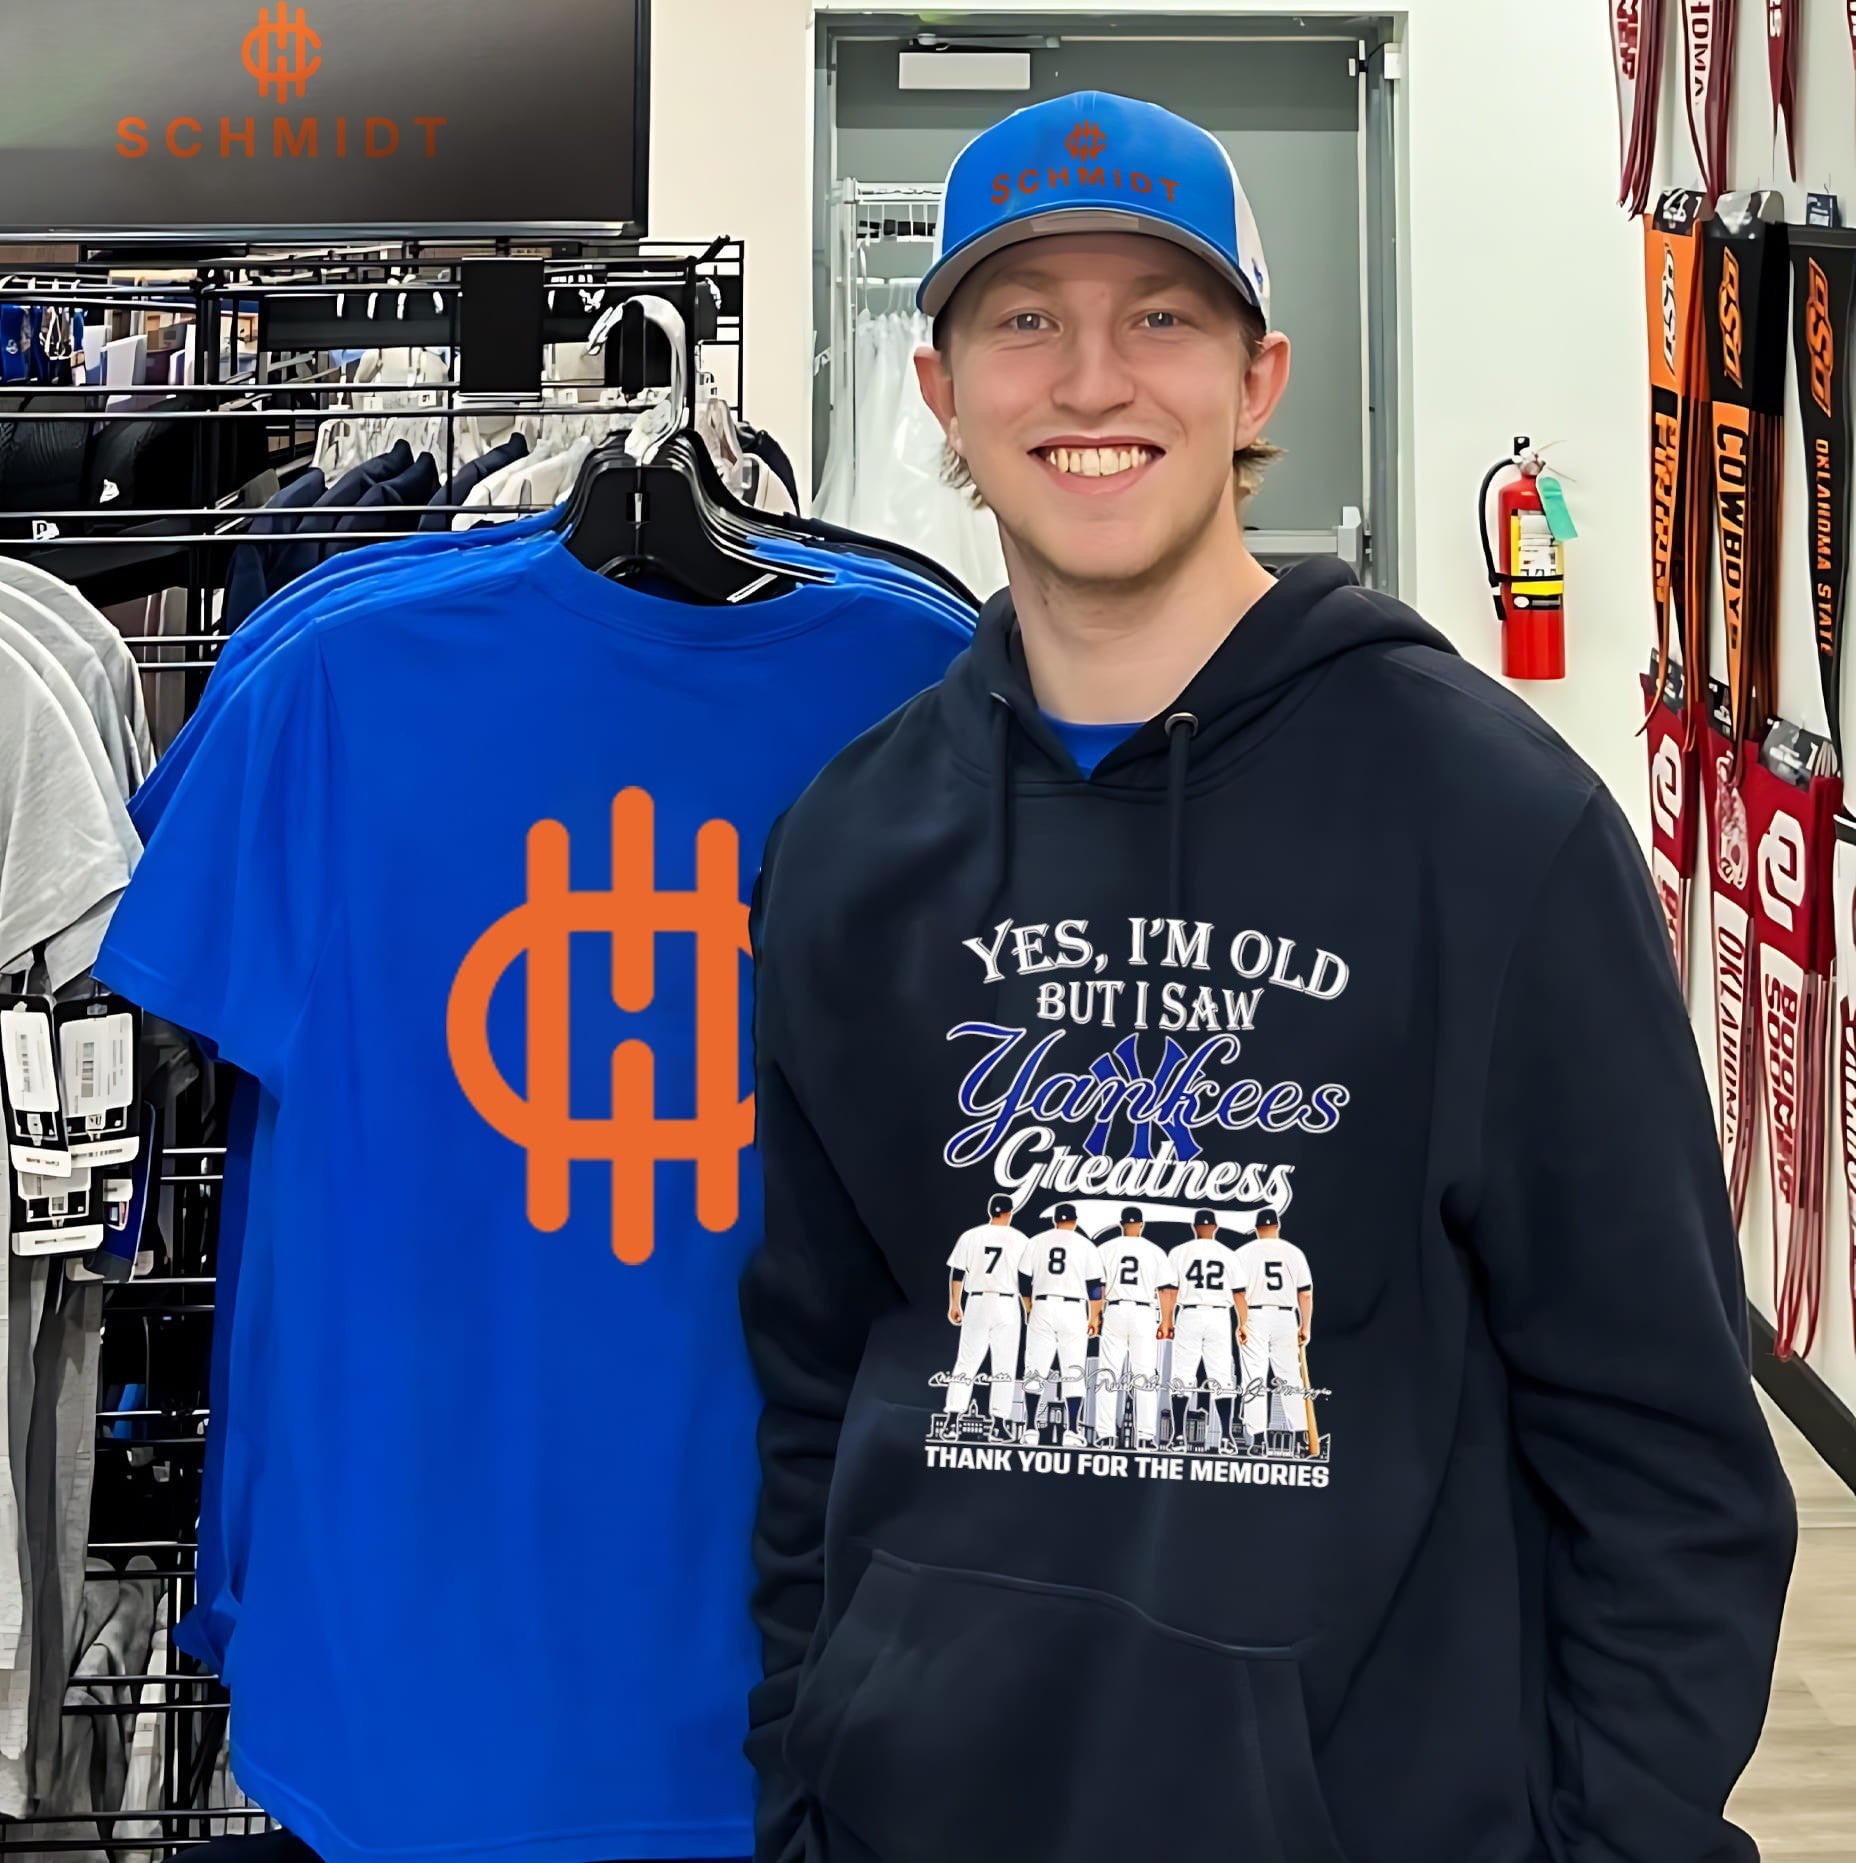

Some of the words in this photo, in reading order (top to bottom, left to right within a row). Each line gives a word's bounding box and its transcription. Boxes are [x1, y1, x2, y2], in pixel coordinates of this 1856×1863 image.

[116, 117, 447, 158] SCHMIDT
[992, 167, 1179, 204] SCHMIDT
[962, 917, 1109, 984] YES,
[1128, 917, 1215, 971] I'M
[1230, 930, 1350, 1000] OLD
[1036, 981, 1126, 1027] BUT
[1133, 982, 1149, 1030] I
[1159, 985, 1265, 1031] SAW
[943, 1021, 1351, 1168] Yankees
[993, 1125, 1295, 1216] Greatness
[984, 1247, 1003, 1274] 7
[1048, 1247, 1066, 1275] 8
[1120, 1256, 1139, 1285] 2
[1185, 1259, 1224, 1291] 42
[1264, 1261, 1283, 1291] 5
[924, 1446, 1012, 1472] THANK
[1018, 1450, 1075, 1475] YOU
[1078, 1454, 1128, 1478] FOR
[1135, 1456, 1183, 1480] THE
[1190, 1459, 1330, 1488] MEMORIES
